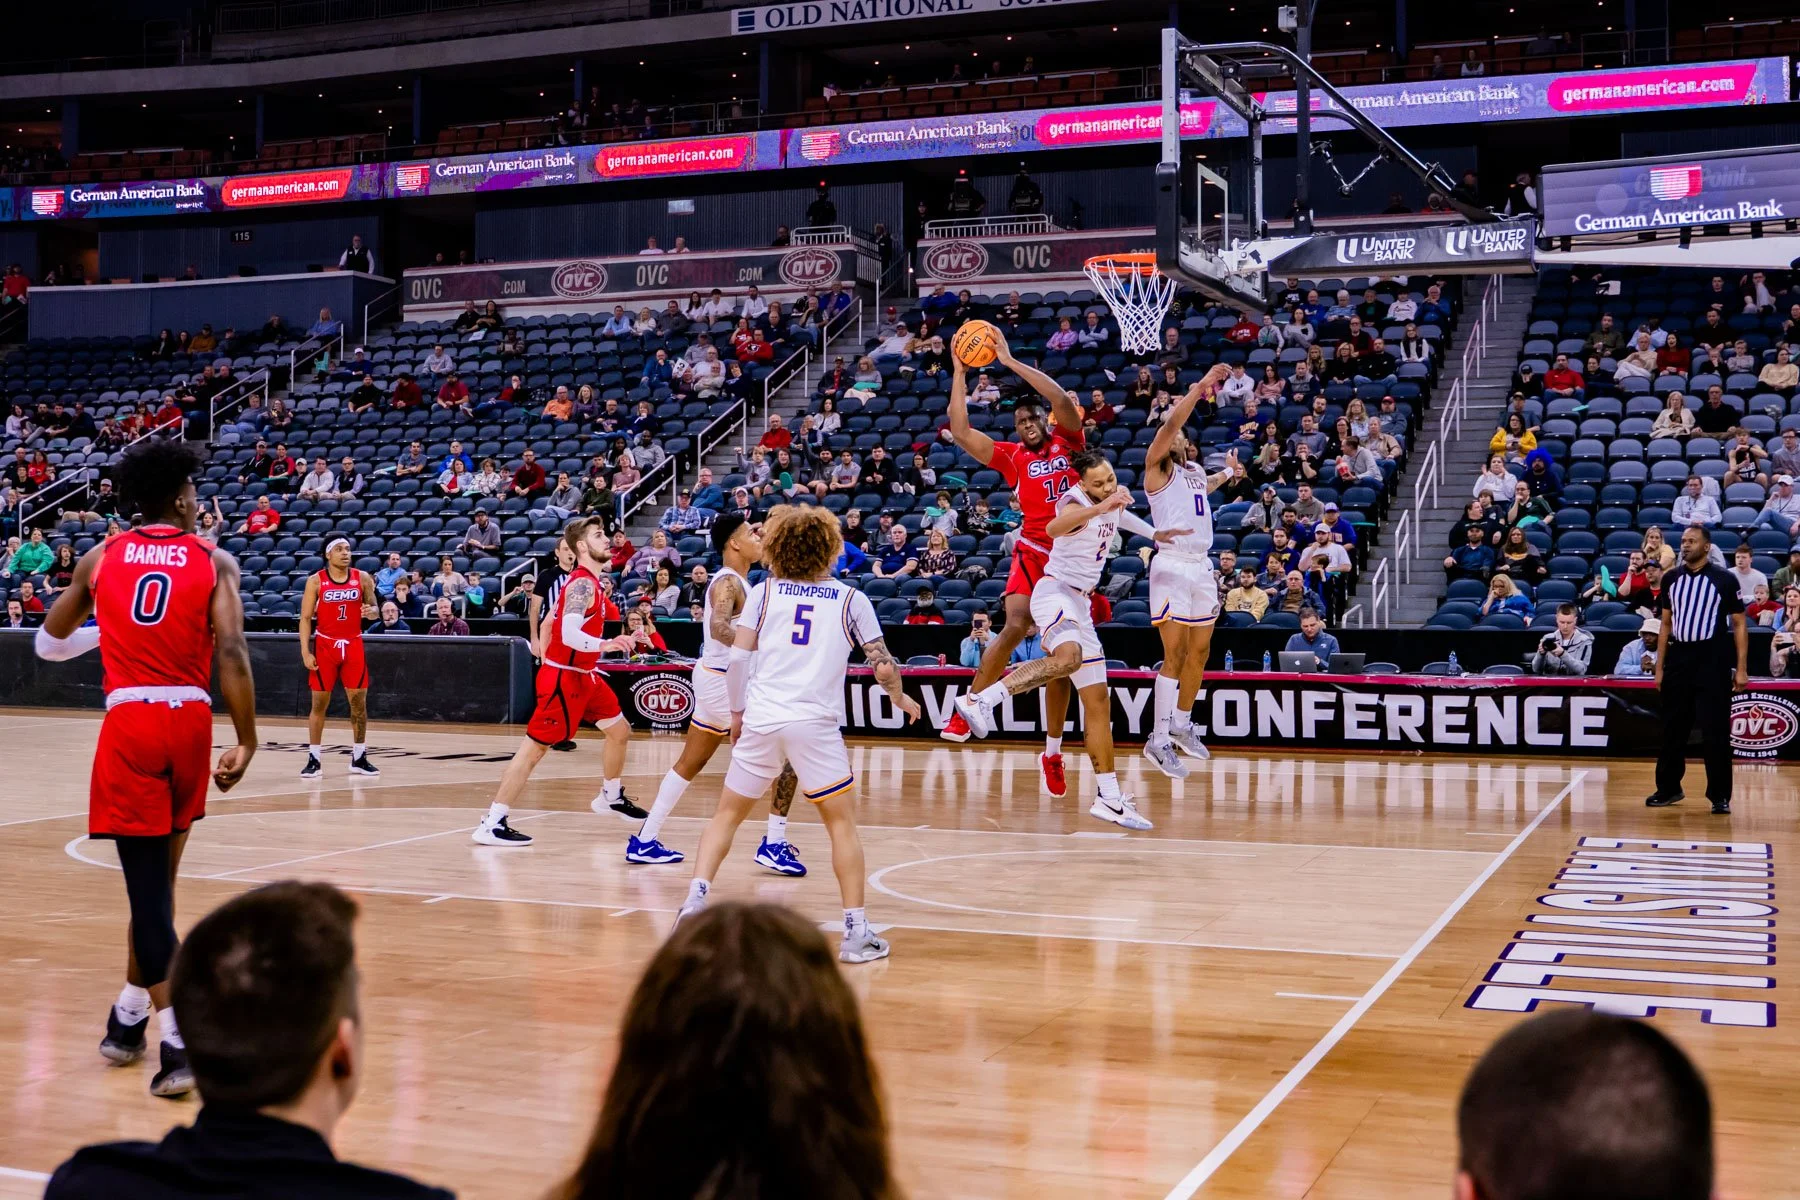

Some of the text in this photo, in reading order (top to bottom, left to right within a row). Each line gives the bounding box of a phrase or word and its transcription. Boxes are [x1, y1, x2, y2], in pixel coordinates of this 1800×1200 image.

[765, 4, 822, 29] OLD
[1399, 87, 1477, 107] American
[1478, 82, 1520, 101] Bank
[1562, 77, 1735, 105] germanamerican.com
[848, 130, 905, 145] German
[906, 124, 974, 141] American
[975, 119, 1012, 135] Bank
[436, 152, 576, 177] German American Bank
[607, 148, 733, 170] germanamerican.com
[70, 183, 205, 203] German American Bank
[231, 180, 339, 201] germanamerican.com
[1575, 213, 1648, 232] German
[1649, 205, 1736, 226] American
[1737, 199, 1784, 219] Bank
[235, 232, 250, 241] 115
[1362, 237, 1416, 252] UNITED
[1471, 229, 1526, 244] UNITED
[1485, 238, 1526, 253] BANK
[937, 252, 974, 270] OVC
[1374, 248, 1414, 261] BANK
[792, 259, 827, 276] OVC
[563, 273, 595, 288] OVC
[961, 335, 982, 360] Wilson
[1043, 475, 1071, 502] 14
[1194, 493, 1205, 516] 0
[123, 542, 188, 568] BARNES
[1095, 540, 1107, 562] 2
[130, 571, 173, 626] 0
[323, 588, 360, 603] SEMO
[778, 582, 840, 600] THOMPSON
[337, 604, 348, 621] 1
[791, 603, 815, 646] 5
[660, 673, 694, 689] EXCELLENC
[648, 694, 681, 710] OVC
[1731, 718, 1779, 735] OVC
[1463, 836, 1780, 1028] EVANSVILLE
